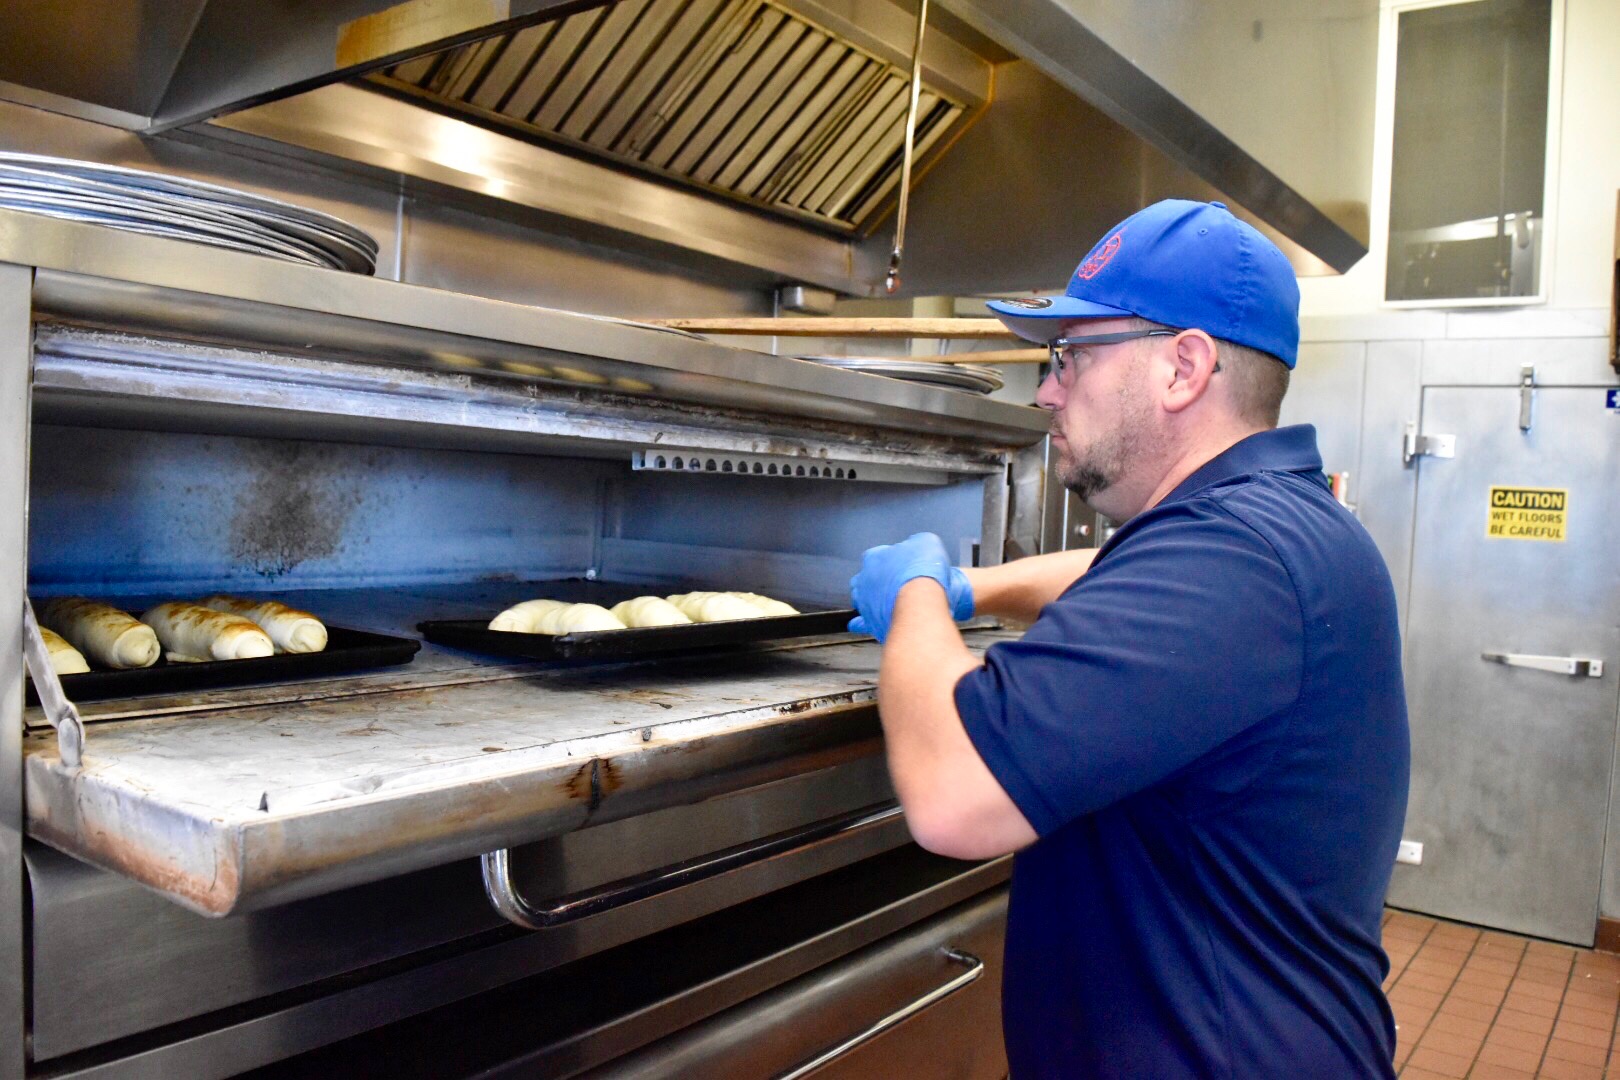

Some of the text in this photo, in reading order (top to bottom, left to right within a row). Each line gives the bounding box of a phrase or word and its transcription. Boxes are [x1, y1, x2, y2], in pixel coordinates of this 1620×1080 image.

[1493, 491, 1563, 508] CAUTION
[1491, 511, 1563, 523] WET FLOORS
[1490, 525, 1562, 538] BE CAREFUL
